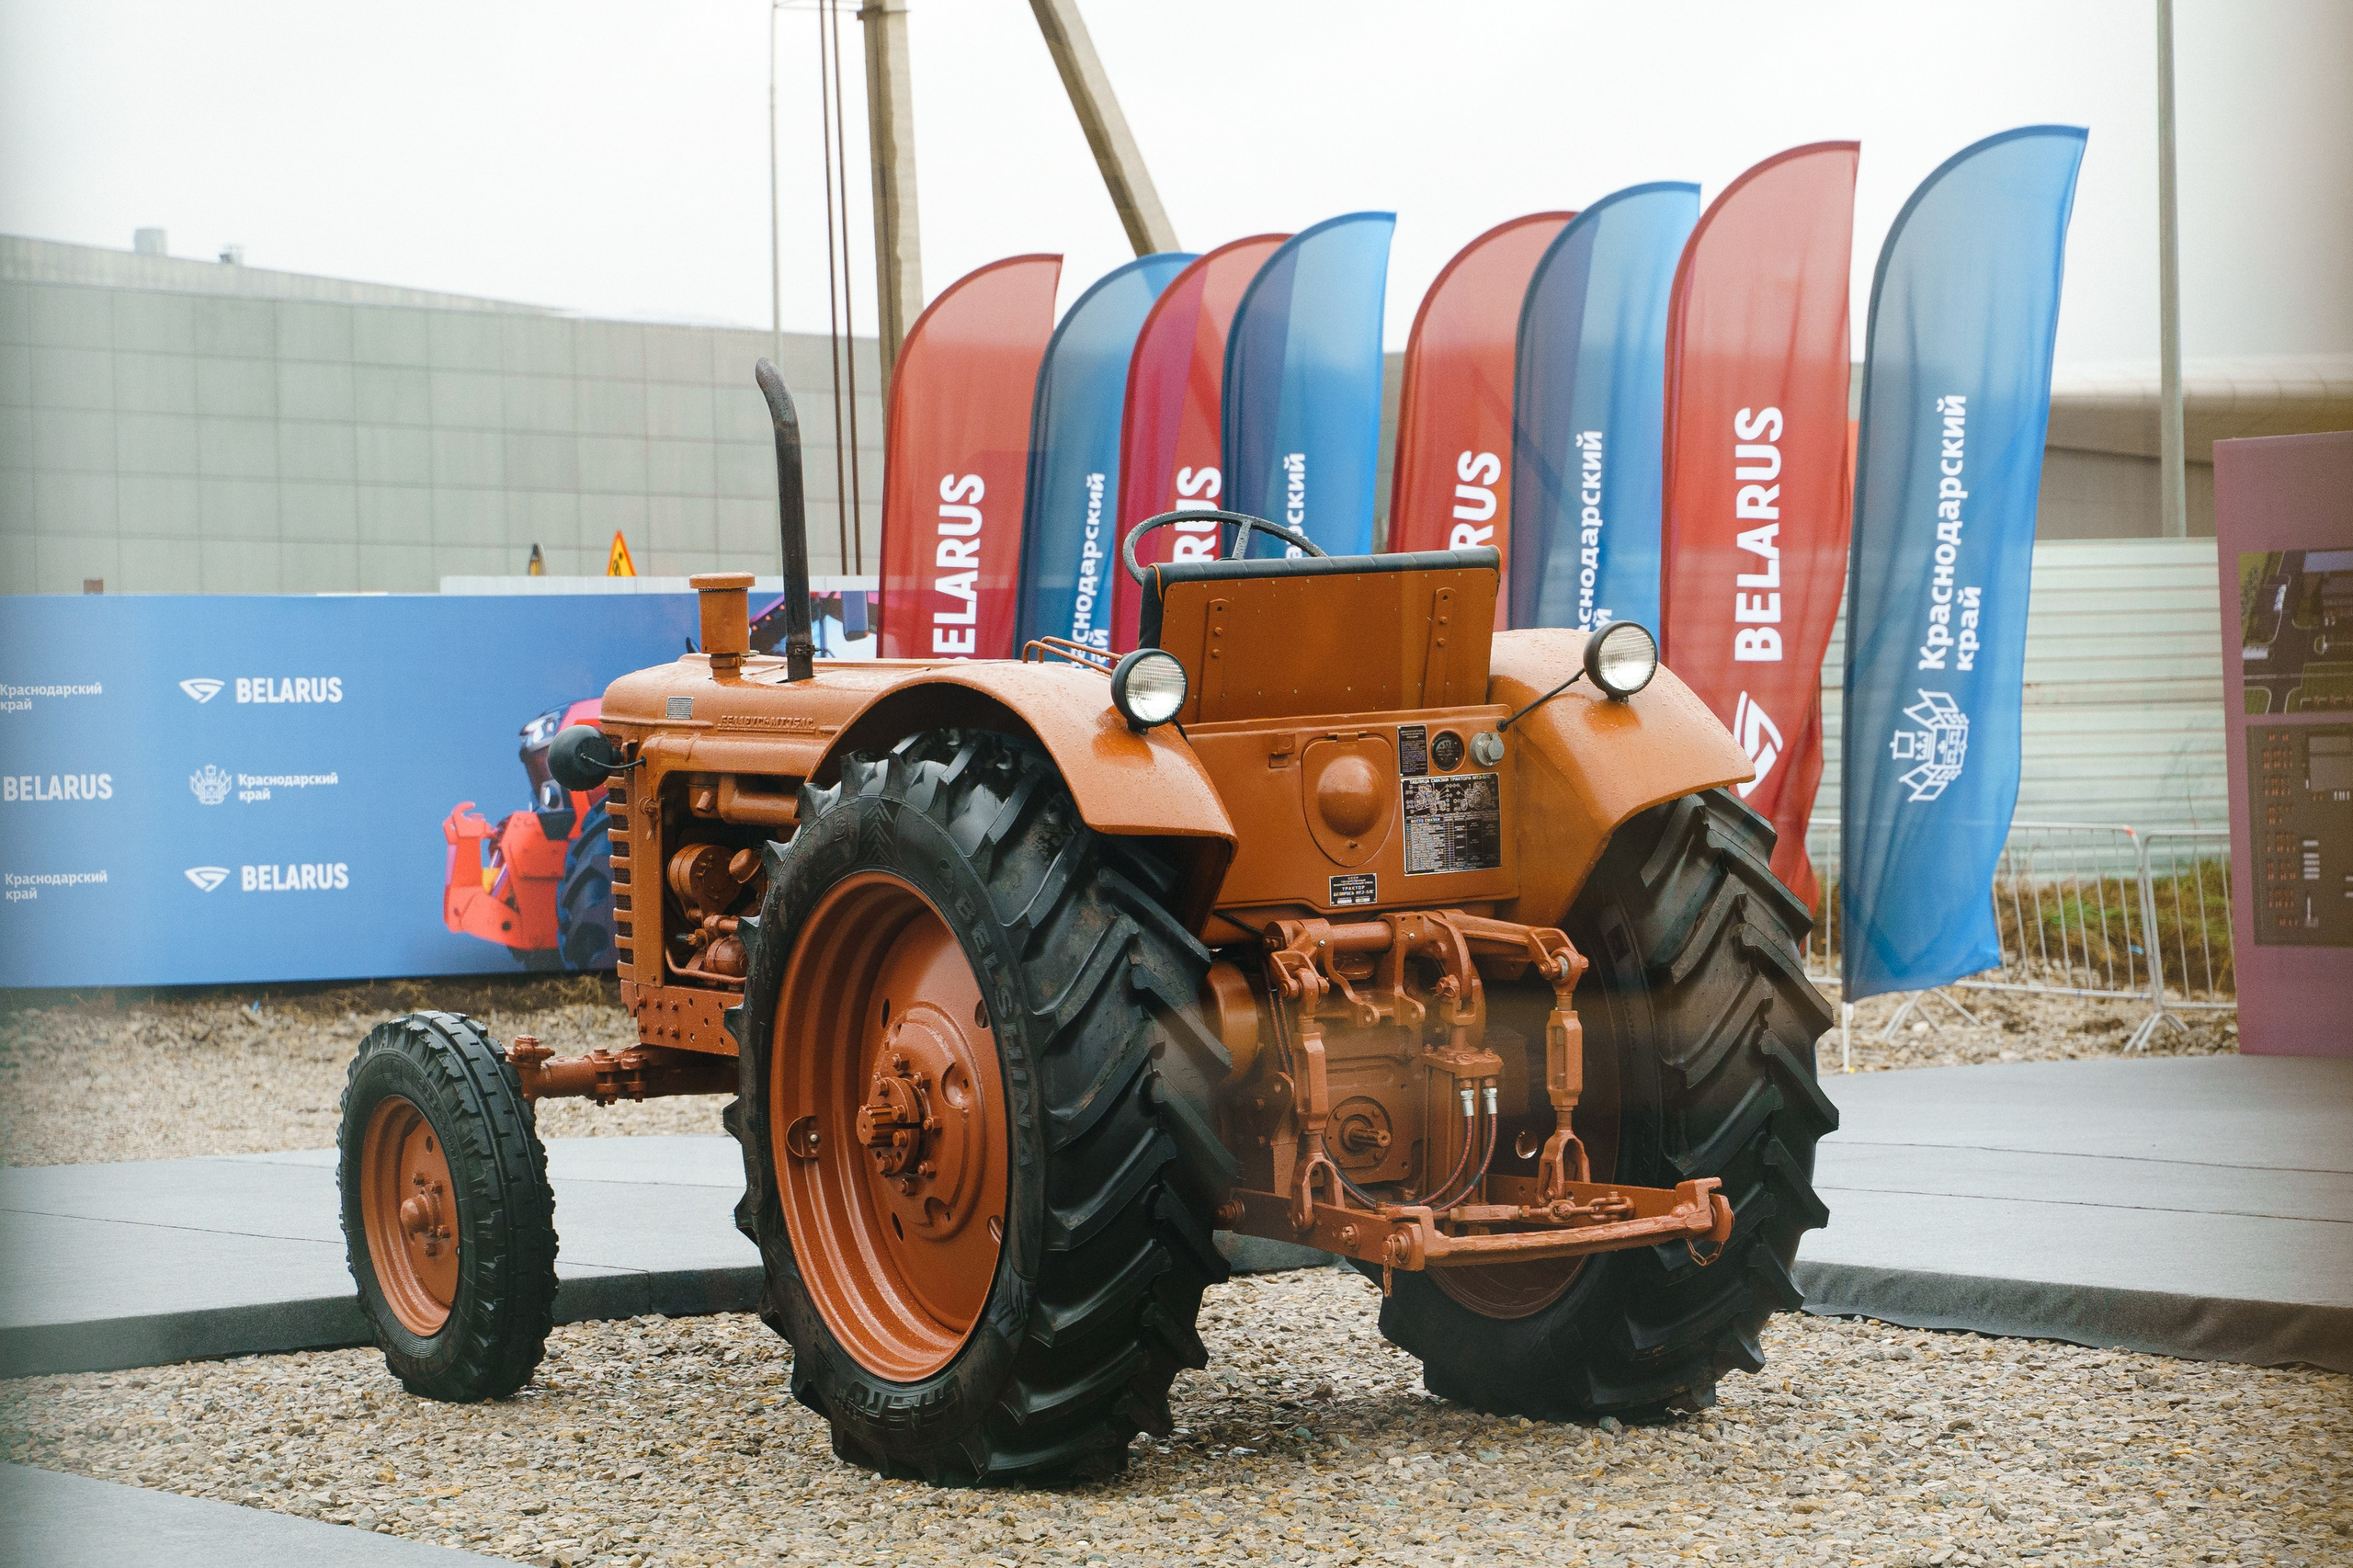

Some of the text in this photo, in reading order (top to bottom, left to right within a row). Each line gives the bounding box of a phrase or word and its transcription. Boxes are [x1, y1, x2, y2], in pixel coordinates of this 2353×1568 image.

[1733, 406, 1784, 662] BELARUS
[1918, 394, 1969, 671] Краснодарский
[933, 473, 985, 657] ELARUS
[1956, 585, 1982, 671] край
[0, 682, 103, 699] Краснодарский
[235, 676, 343, 704] BELARUS
[0, 698, 32, 713] край
[4, 773, 113, 801] BELARUS
[238, 771, 339, 790] Краснодарский
[239, 788, 271, 802] край
[5, 869, 108, 887] Краснодарский
[242, 862, 349, 892] BELARUS
[6, 886, 39, 903] край
